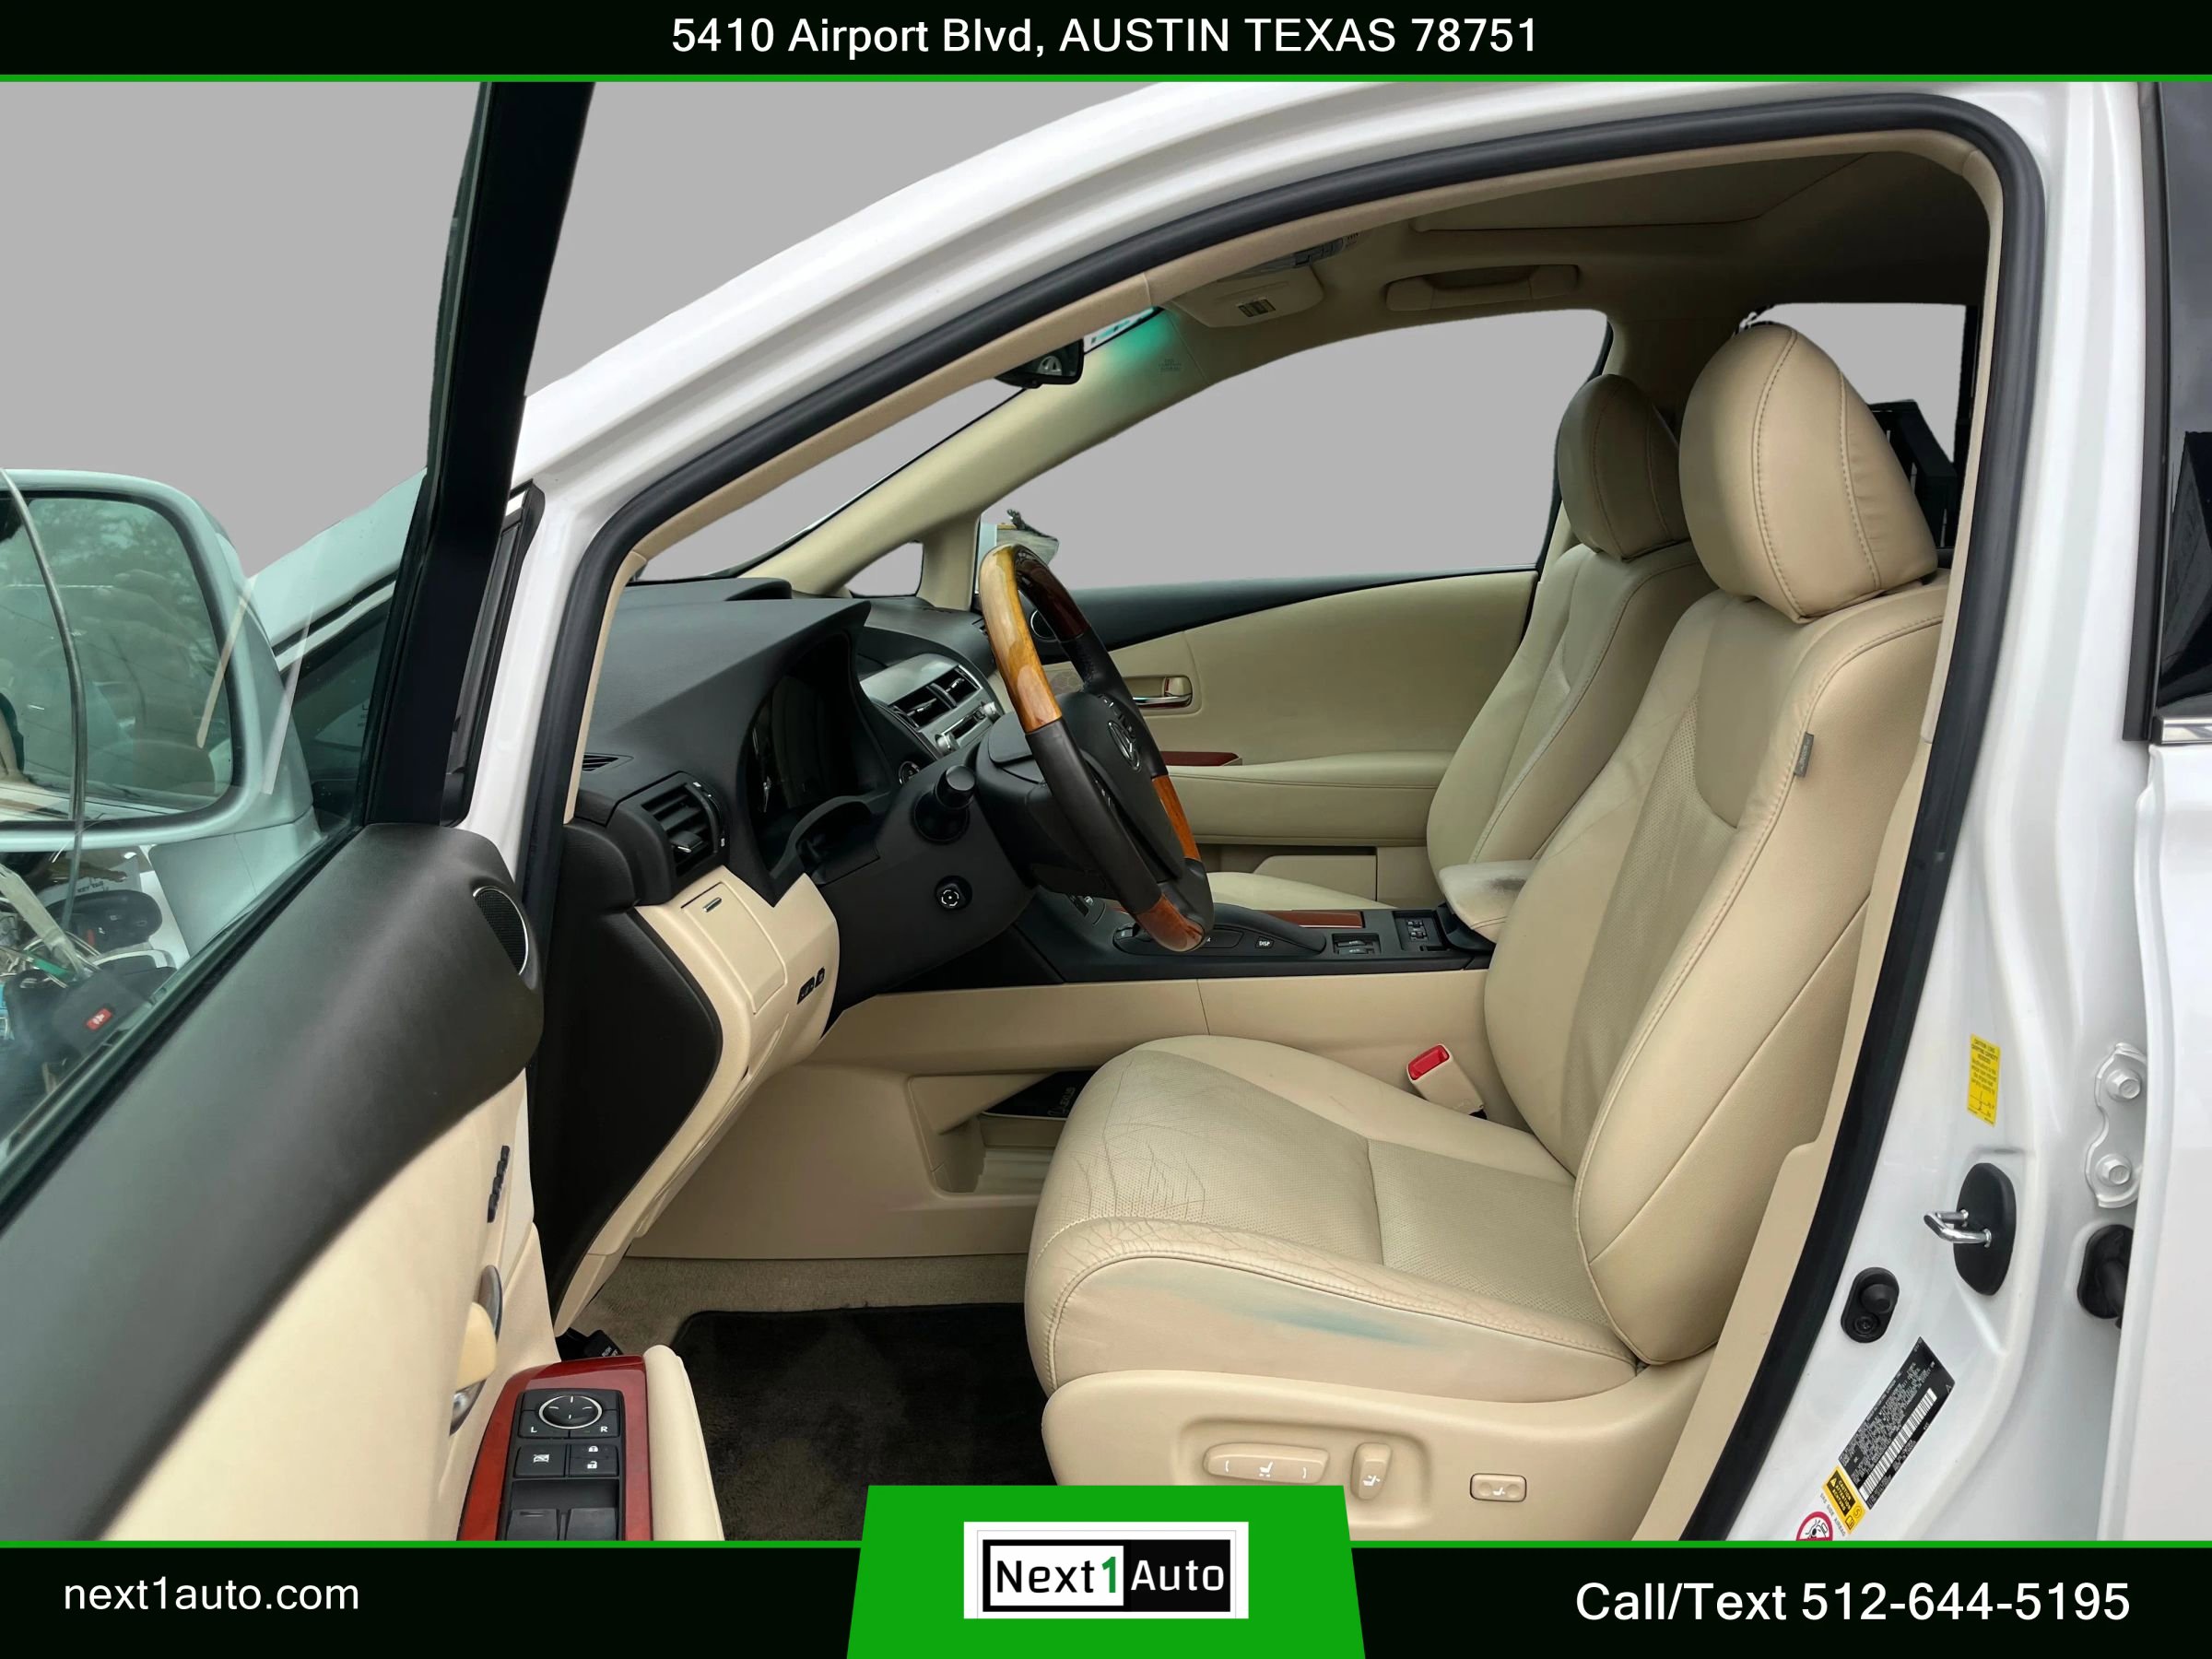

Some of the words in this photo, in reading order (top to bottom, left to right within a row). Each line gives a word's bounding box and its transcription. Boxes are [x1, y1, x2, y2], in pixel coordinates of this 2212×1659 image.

[600, 1425, 608, 1433] R
[1835, 1485, 1852, 1510] ATTENTION
[1839, 1480, 1851, 1500] CAUTION
